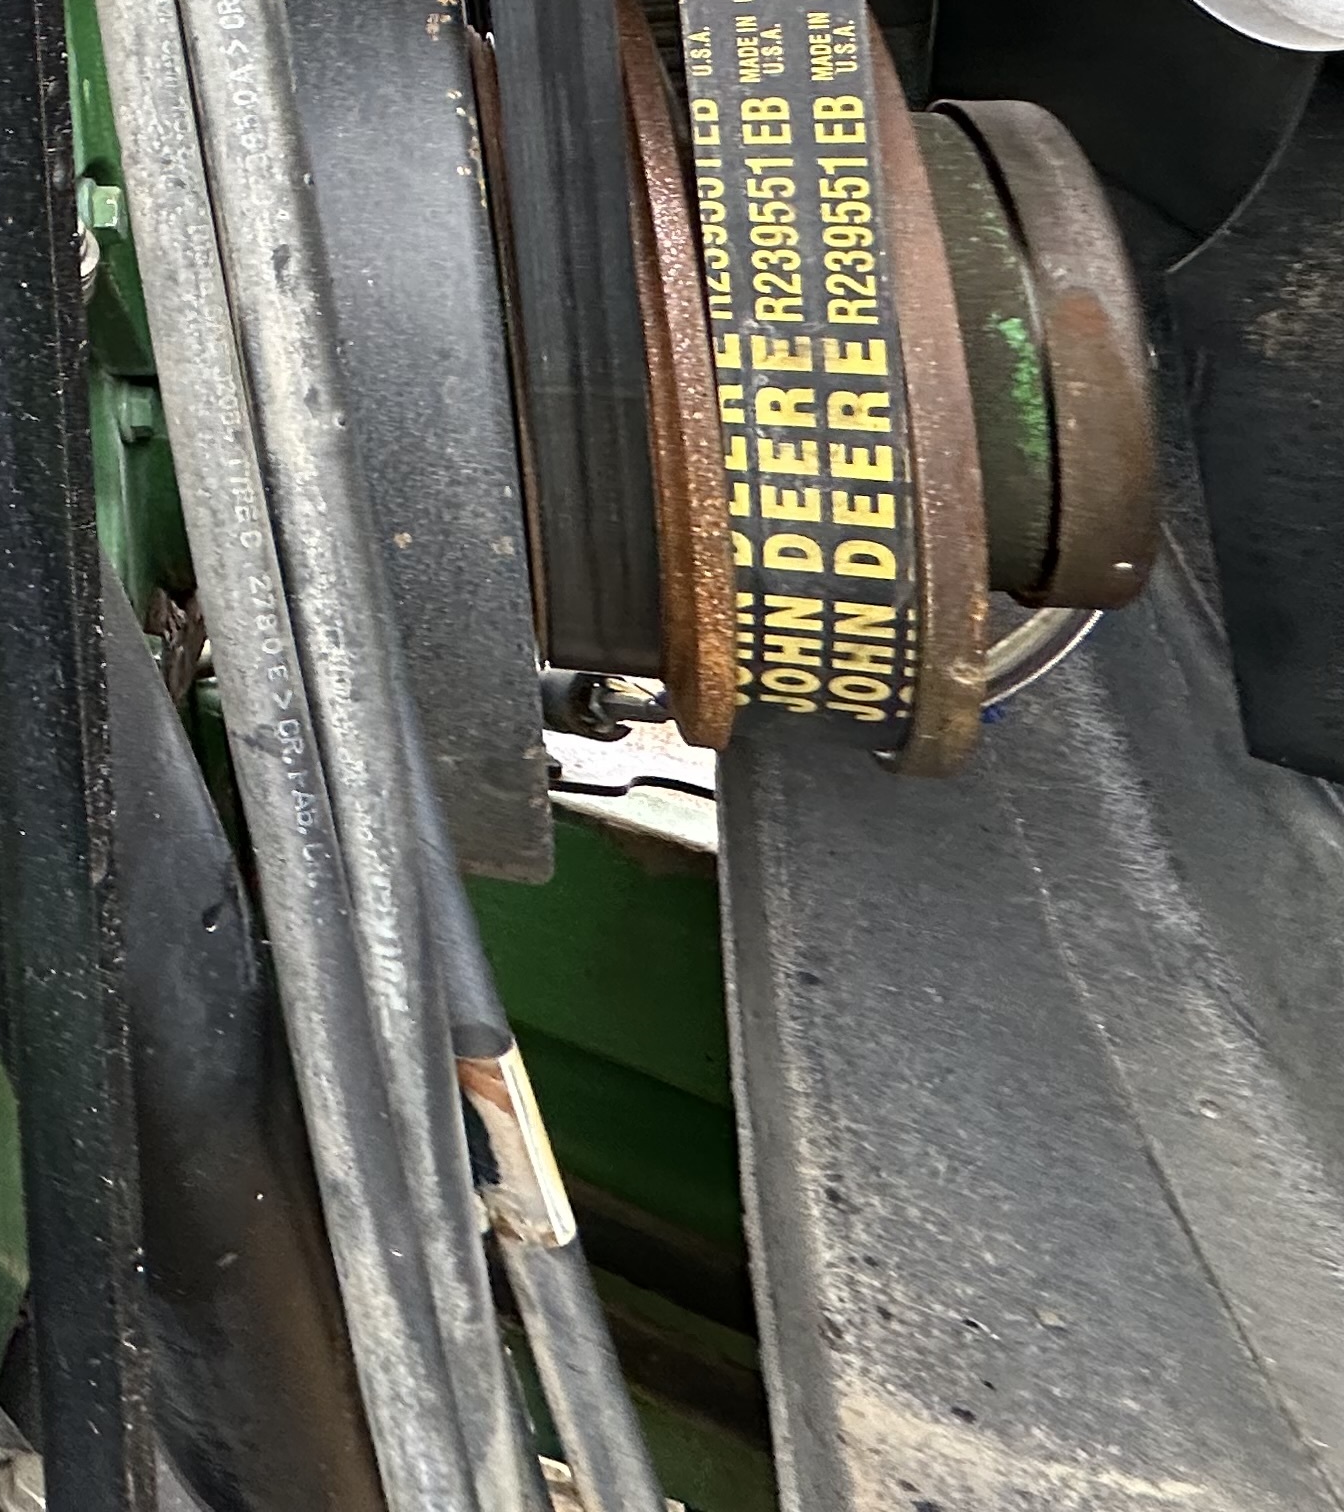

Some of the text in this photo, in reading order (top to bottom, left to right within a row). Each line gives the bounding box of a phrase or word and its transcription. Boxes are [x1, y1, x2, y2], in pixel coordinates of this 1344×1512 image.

[690, 26, 712, 76] U.S.A.
[734, 16, 761, 83] MADE IN
[761, 23, 785, 74] U.S.A.
[807, 12, 835, 80] MADE IN
[834, 20, 858, 73] U.S.A.
[742, 97, 825, 713] JOHN DEERE R239551 EB
[811, 96, 897, 721] JOHN DEERE R239551 EB
